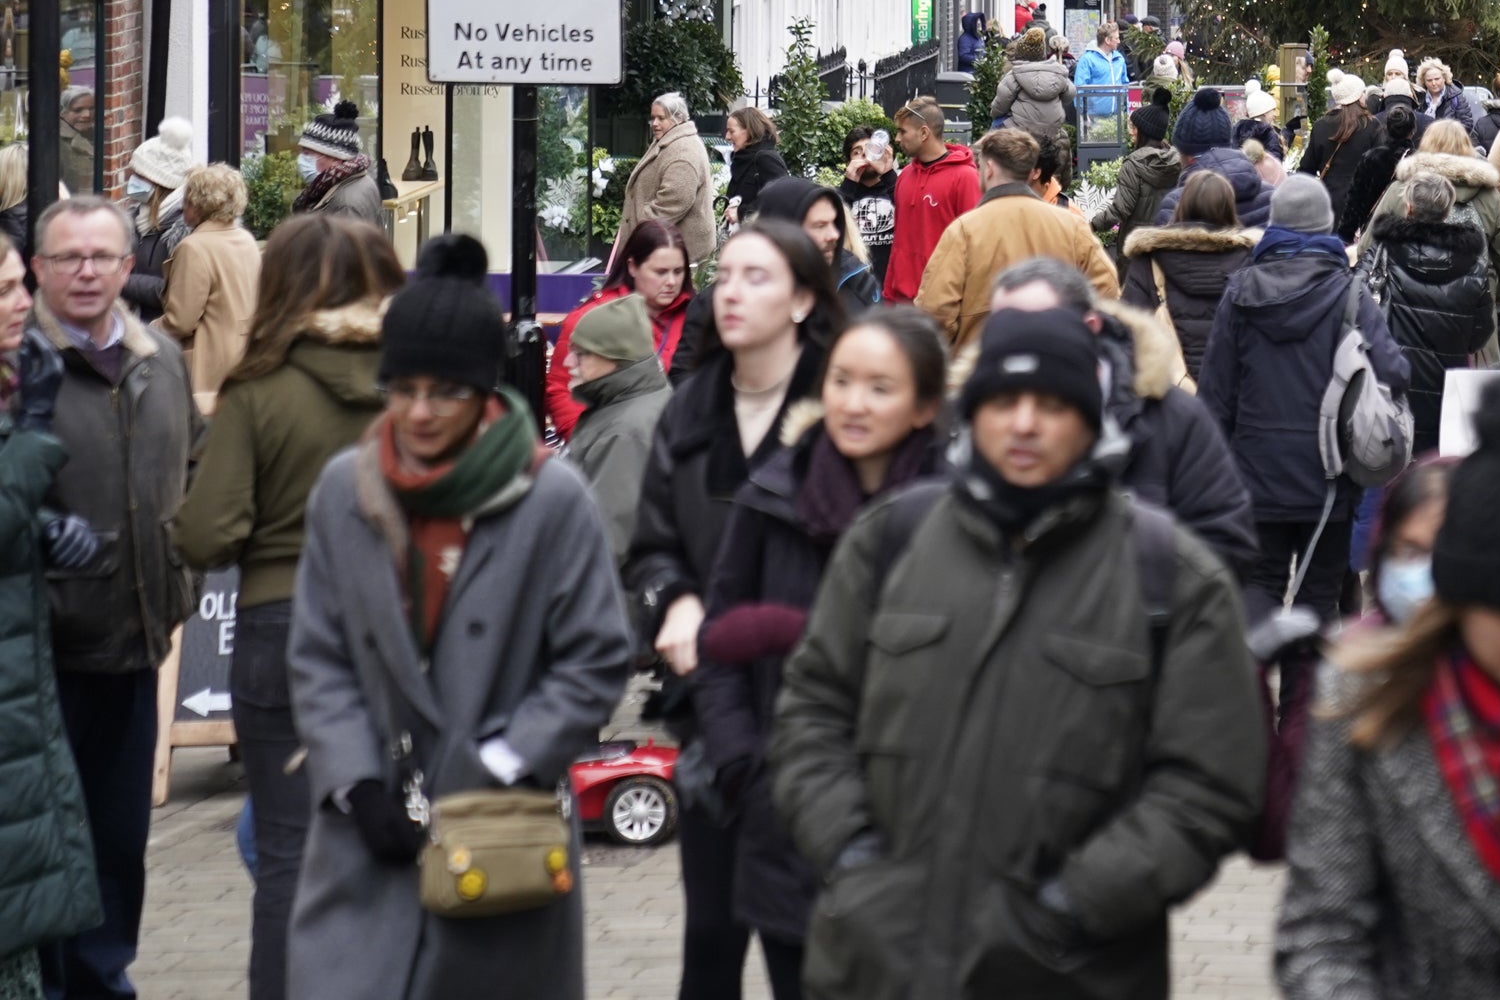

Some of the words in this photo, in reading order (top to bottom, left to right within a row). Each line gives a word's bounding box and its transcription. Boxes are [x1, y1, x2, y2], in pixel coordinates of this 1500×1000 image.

[917, 0, 932, 45] earing
[400, 26, 427, 40] Rus
[454, 22, 488, 42] No
[495, 23, 595, 43] Vehicles
[400, 54, 427, 68] Rus
[457, 51, 484, 70] At
[491, 55, 532, 74] any
[539, 53, 593, 72] time
[400, 82, 444, 96] Russell
